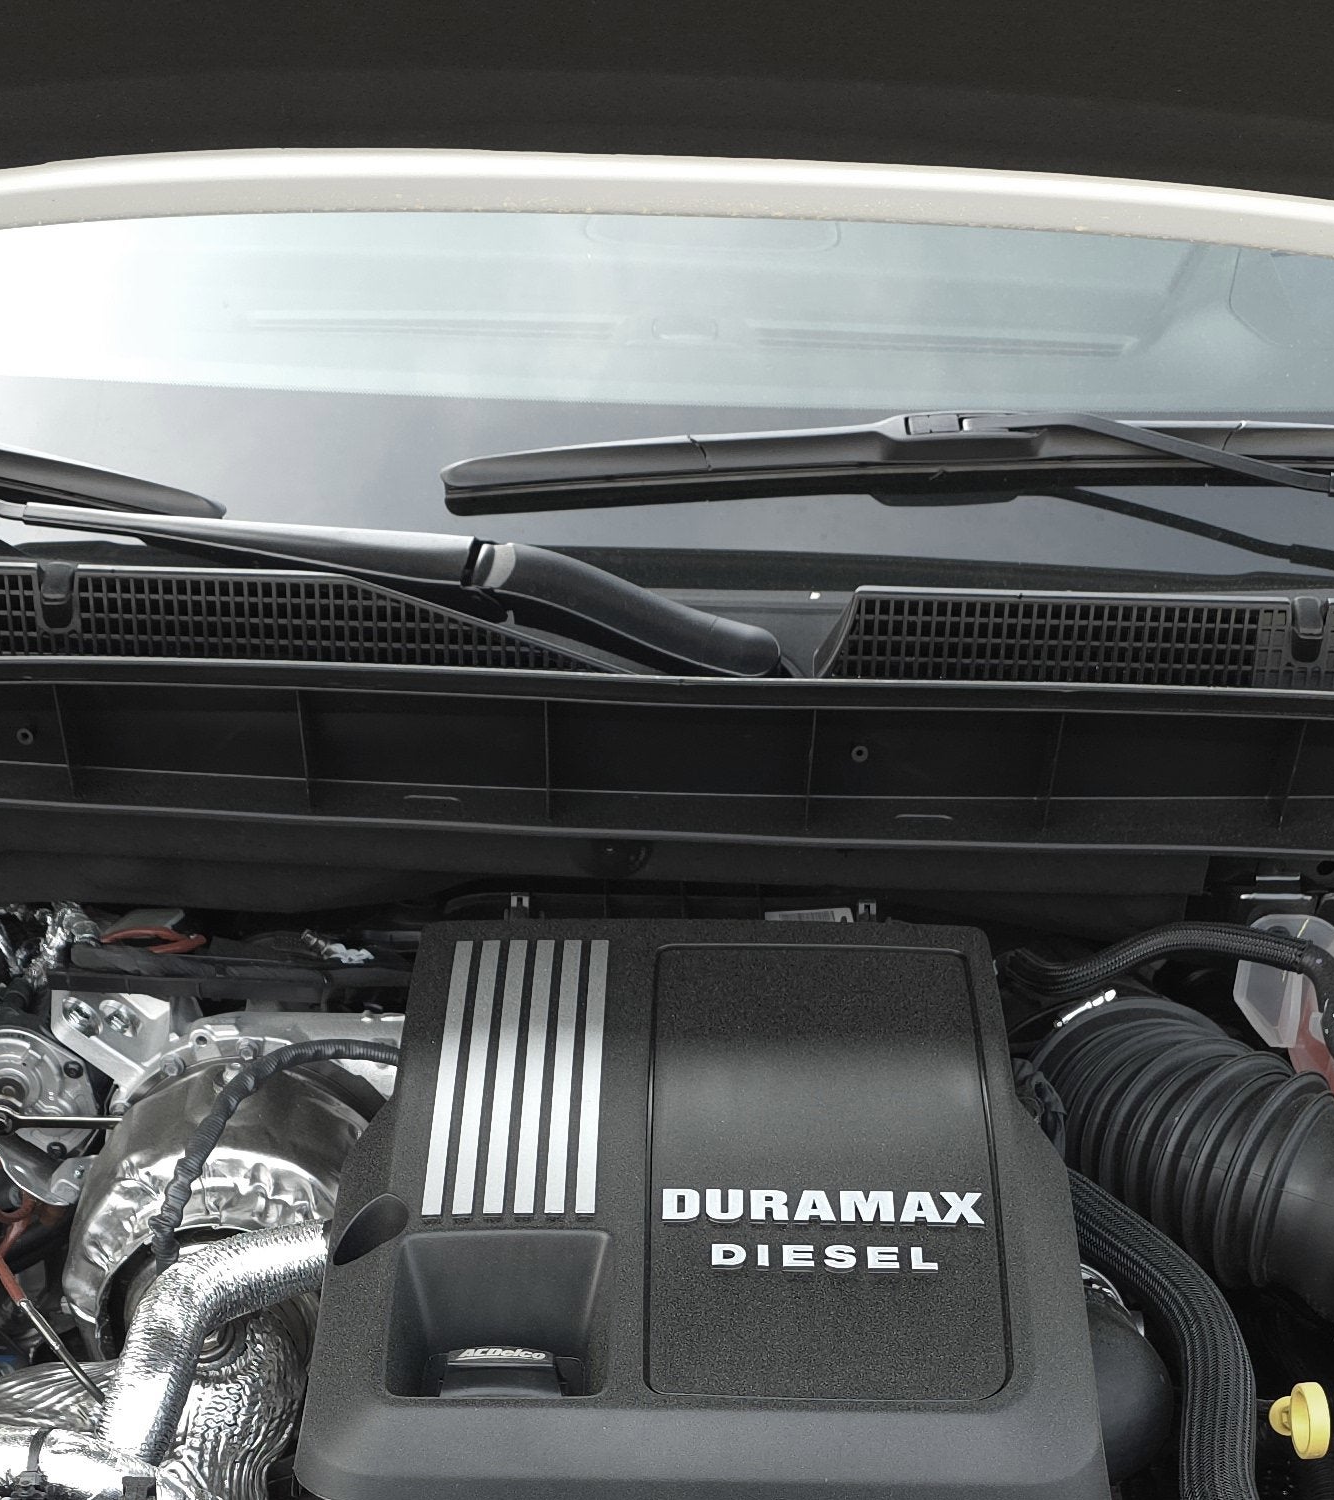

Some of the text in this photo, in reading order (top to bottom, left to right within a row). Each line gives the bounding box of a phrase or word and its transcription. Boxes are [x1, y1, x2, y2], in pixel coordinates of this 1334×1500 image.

[661, 1188, 985, 1225] DURAMAX
[711, 1243, 939, 1271] DIESEL
[456, 1347, 547, 1361] ACDelco
